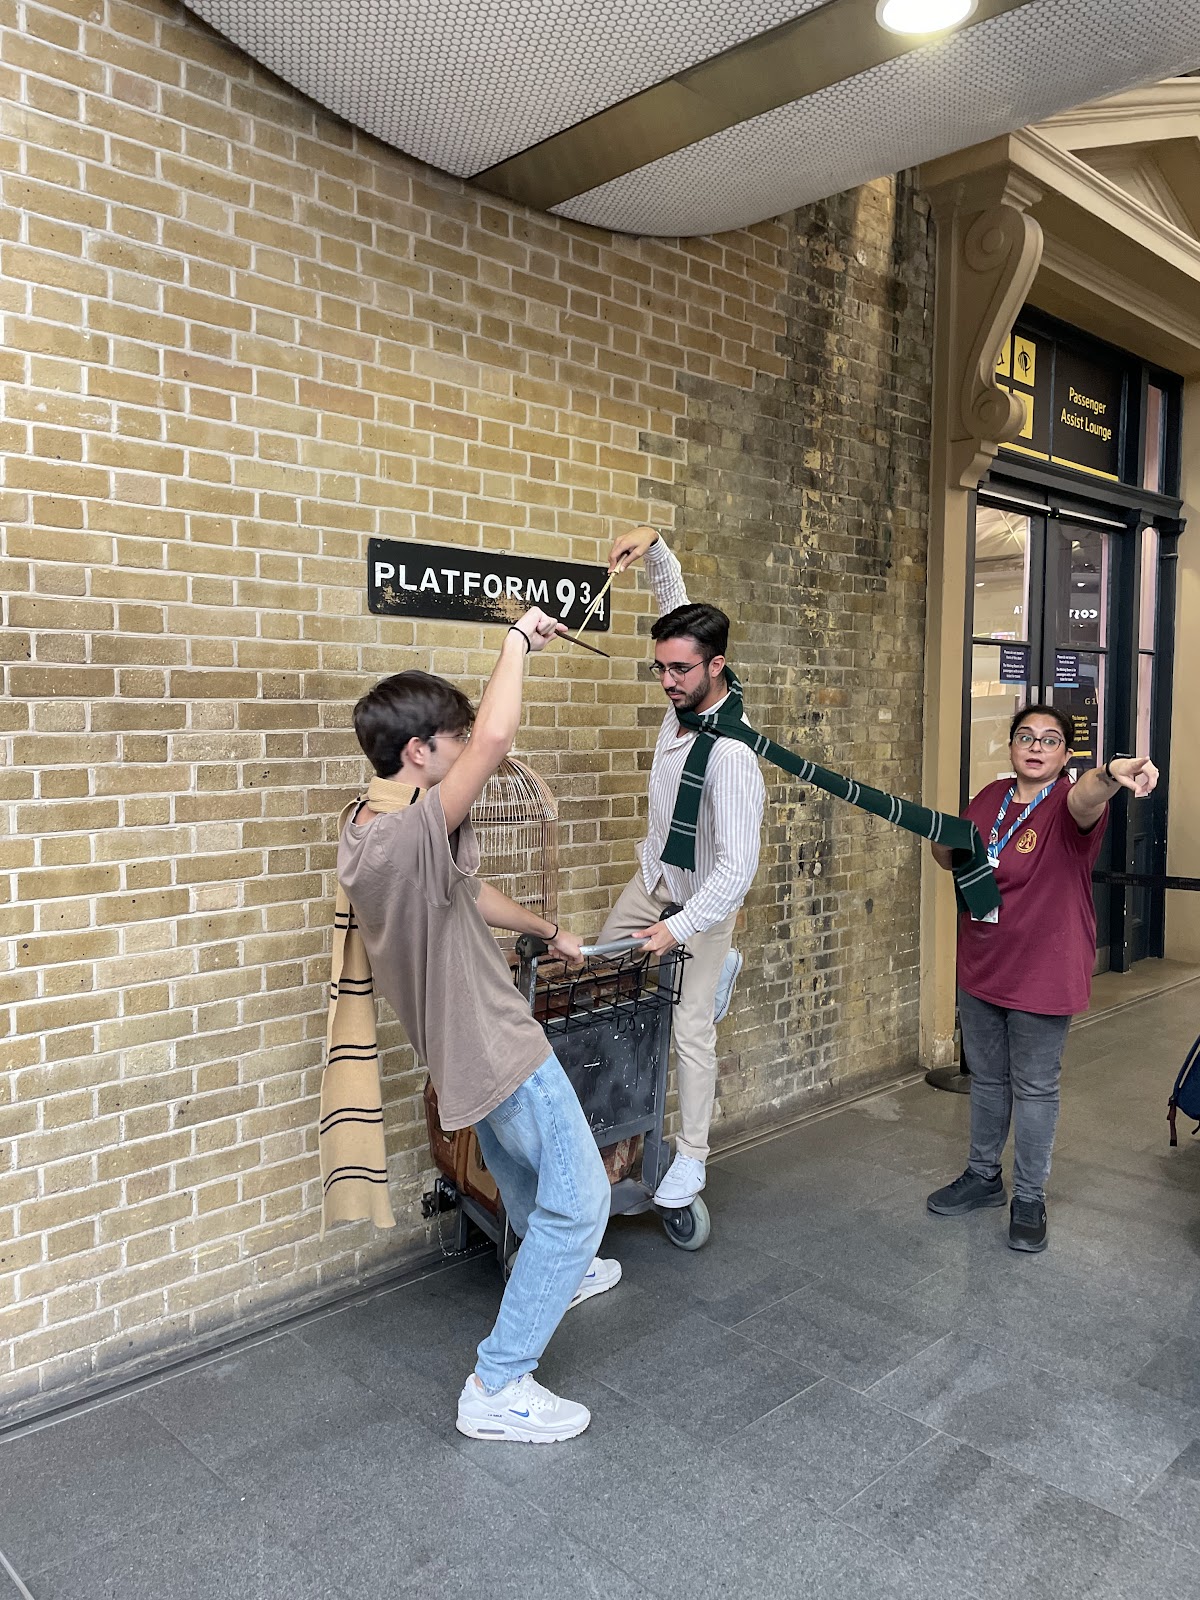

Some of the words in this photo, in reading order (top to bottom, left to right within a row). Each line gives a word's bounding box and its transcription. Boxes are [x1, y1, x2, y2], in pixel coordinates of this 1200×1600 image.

[1069, 386, 1107, 415] Passenger
[1061, 407, 1084, 430] Assist
[1085, 416, 1112, 441] Lounge
[374, 561, 549, 603] PLATFORM
